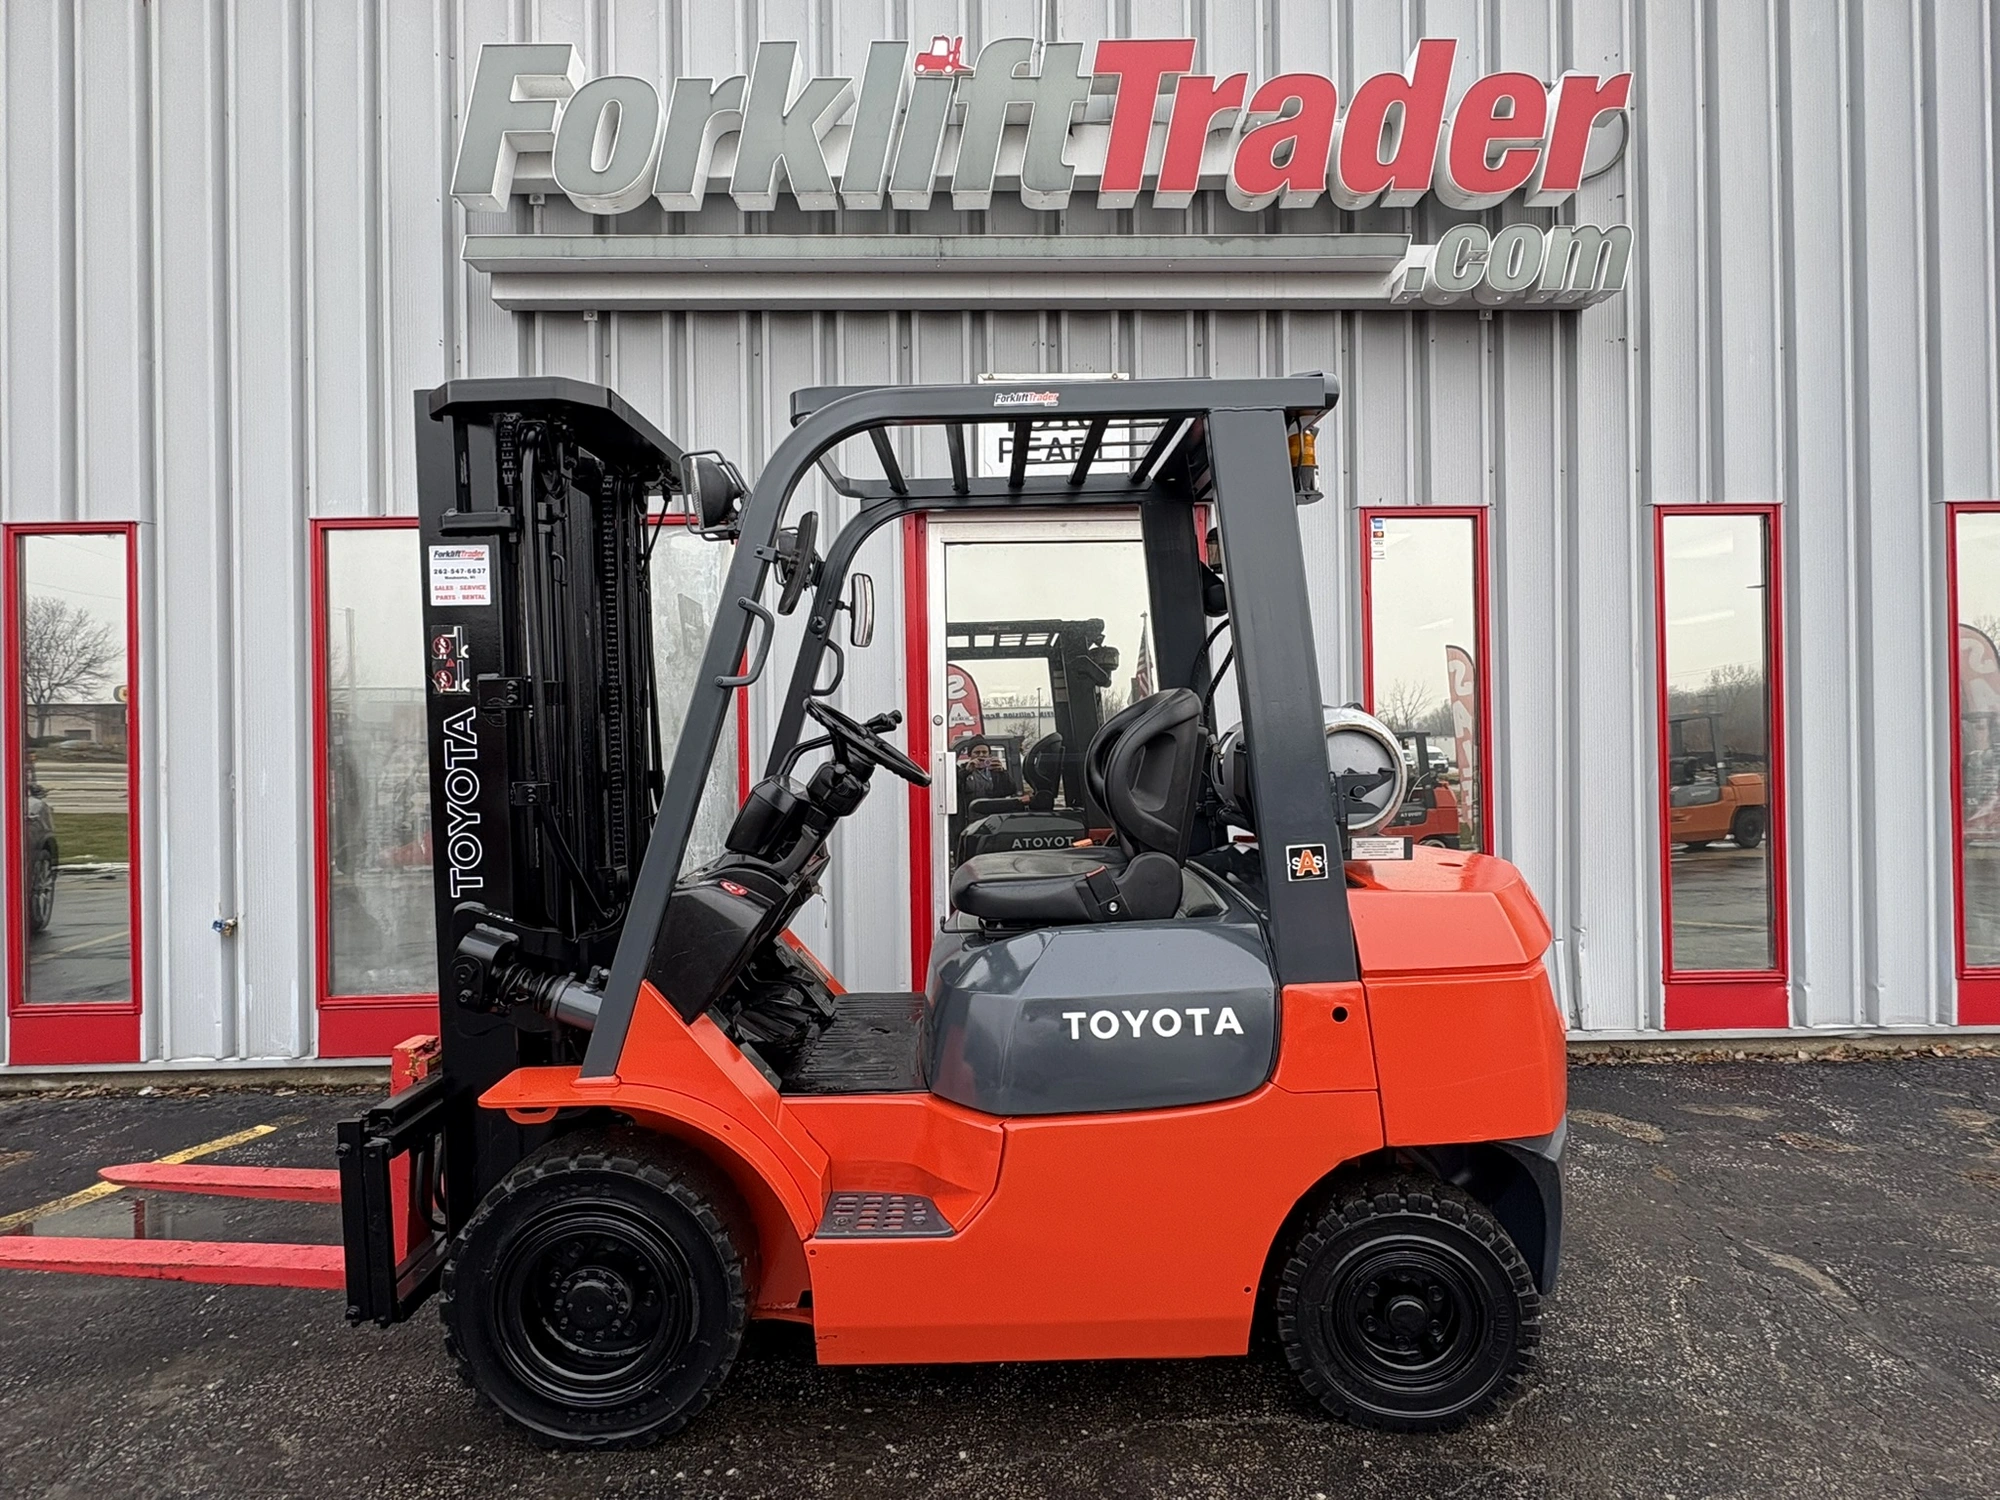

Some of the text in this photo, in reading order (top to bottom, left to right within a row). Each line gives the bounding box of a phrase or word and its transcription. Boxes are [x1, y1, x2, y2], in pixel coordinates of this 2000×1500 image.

[1402, 223, 1634, 294] .com
[995, 392, 1058, 402] ForkliftTrader
[443, 707, 483, 898] TOYOTA
[1291, 849, 1323, 876] SAS
[1062, 1007, 1244, 1040] TOYOTA
